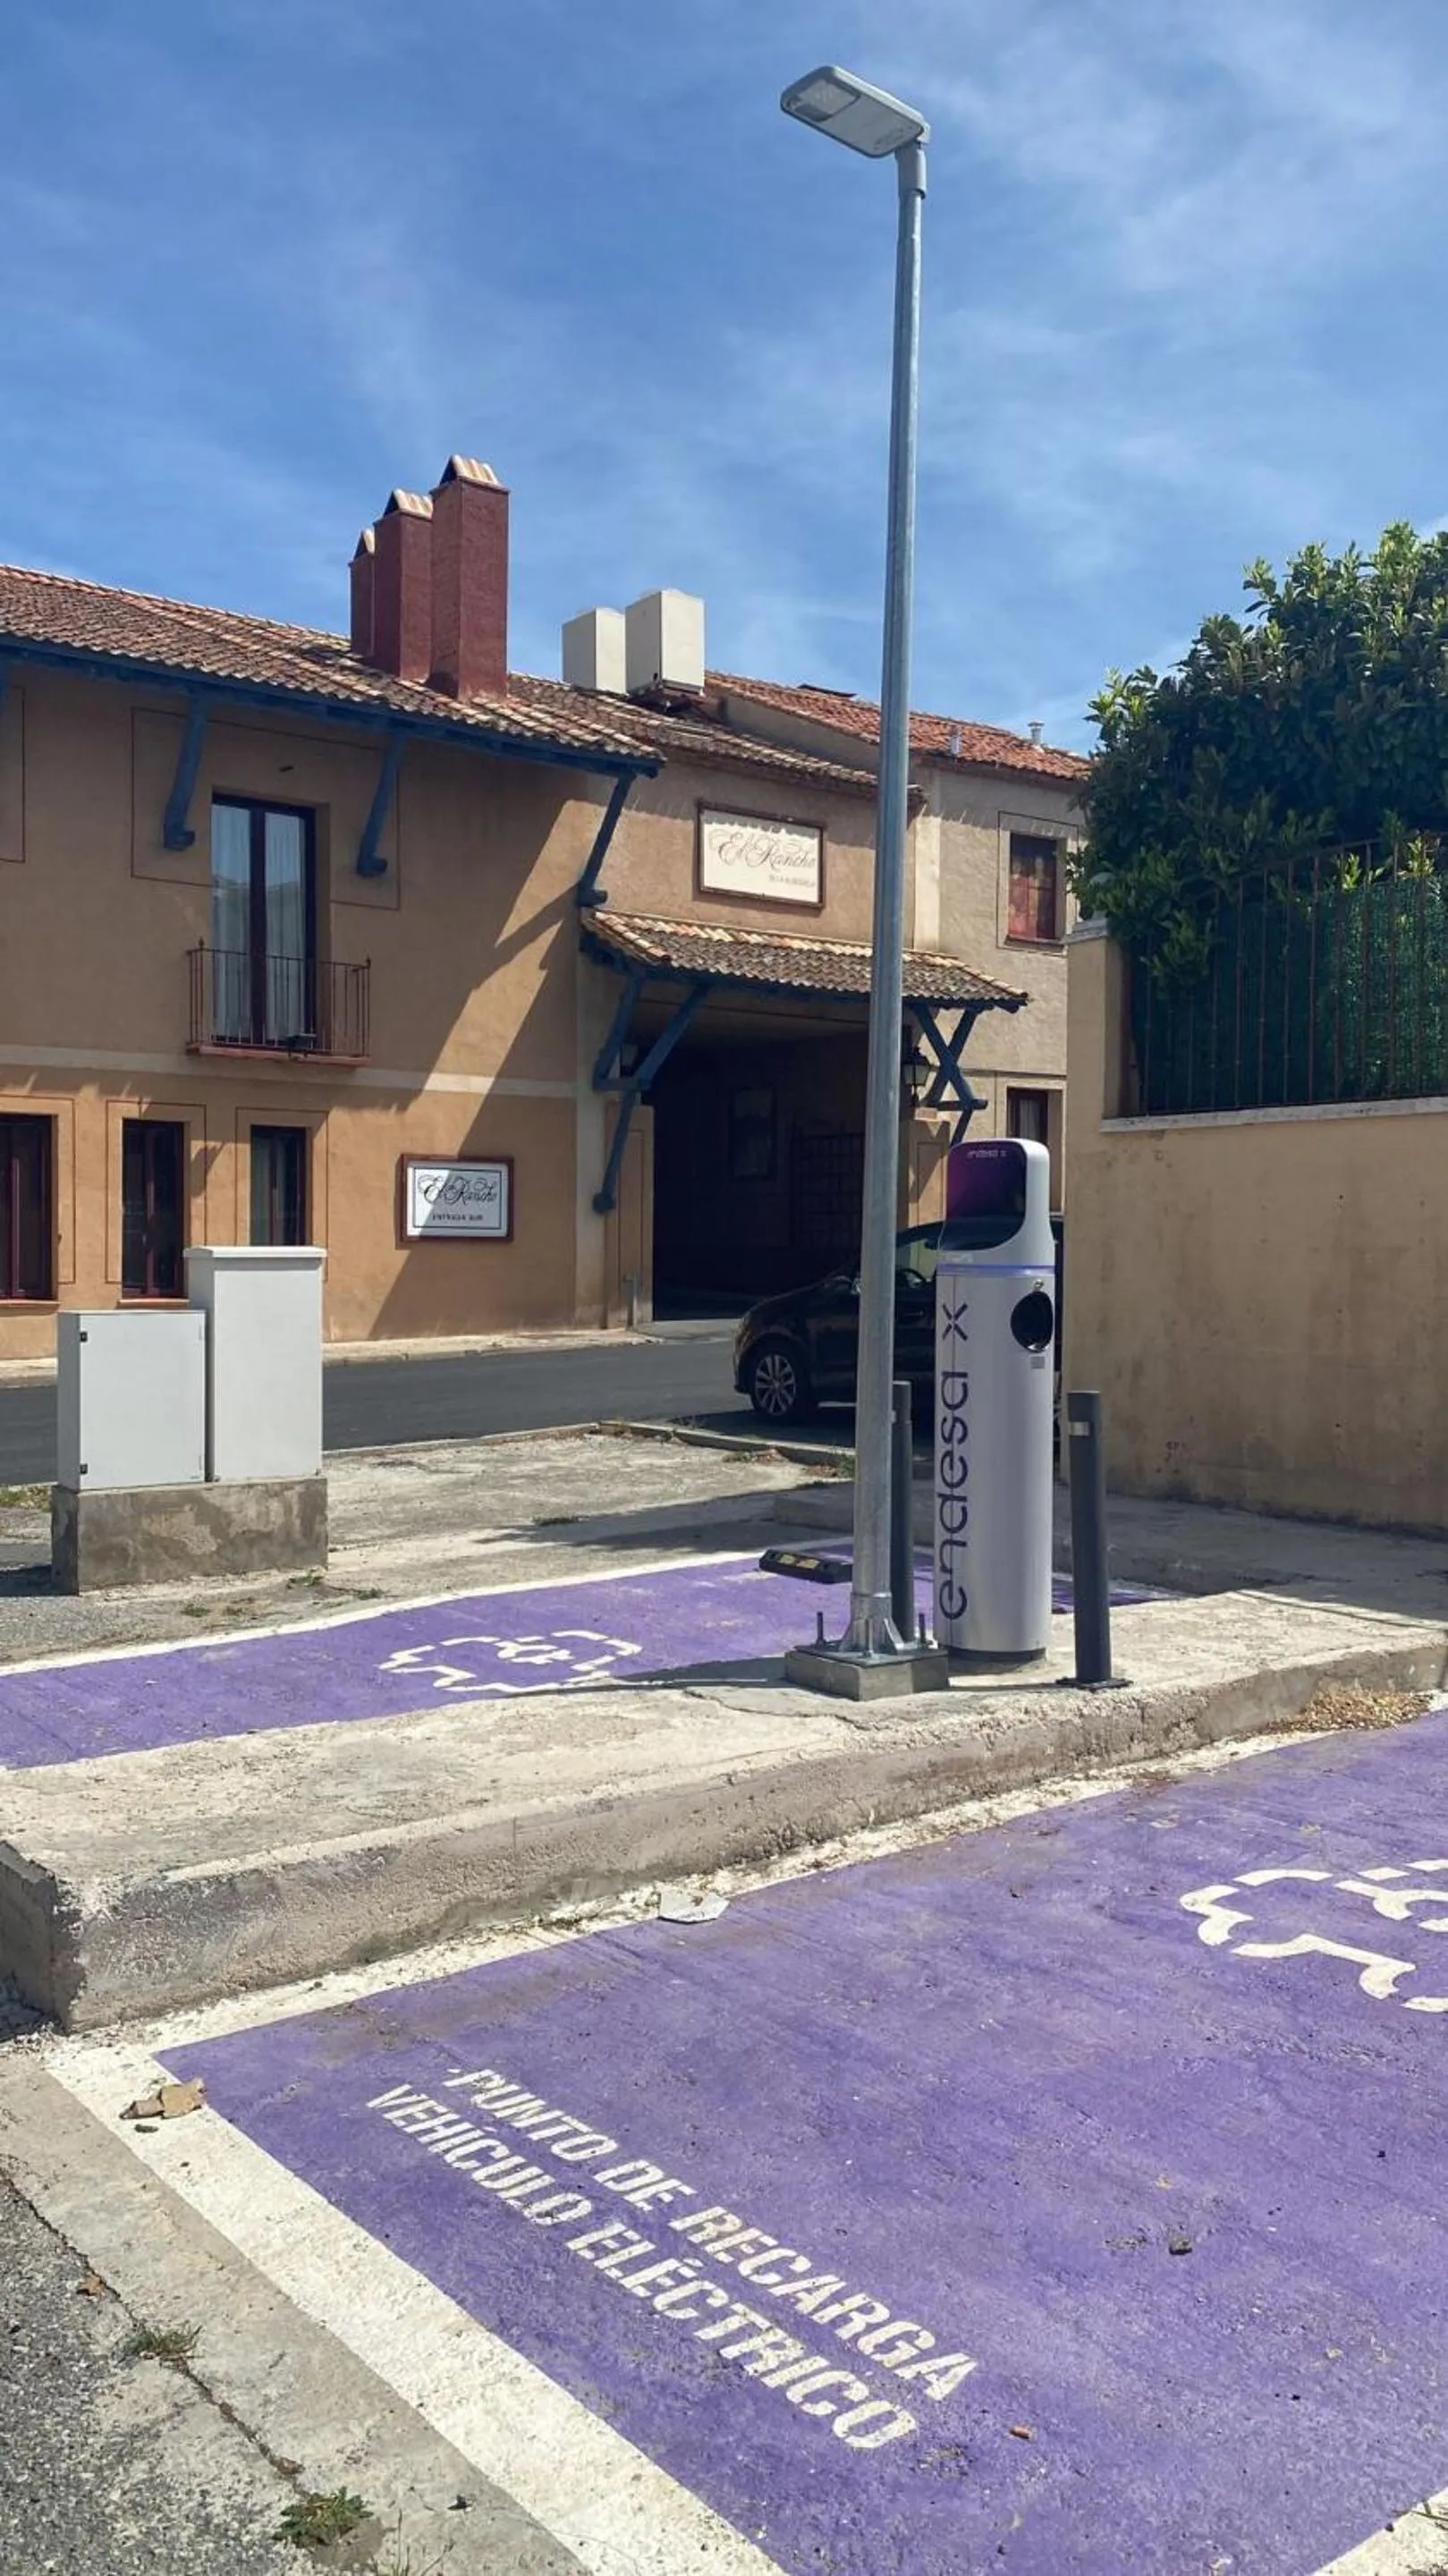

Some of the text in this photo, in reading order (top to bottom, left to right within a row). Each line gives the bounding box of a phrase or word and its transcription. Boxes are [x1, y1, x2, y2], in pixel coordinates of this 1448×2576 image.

[937, 1371, 968, 1621] endesa
[365, 2083, 919, 2450] VEHÍCULO ELÉCTRICO
[443, 2068, 981, 2402] PUNTO DE RECARGA
